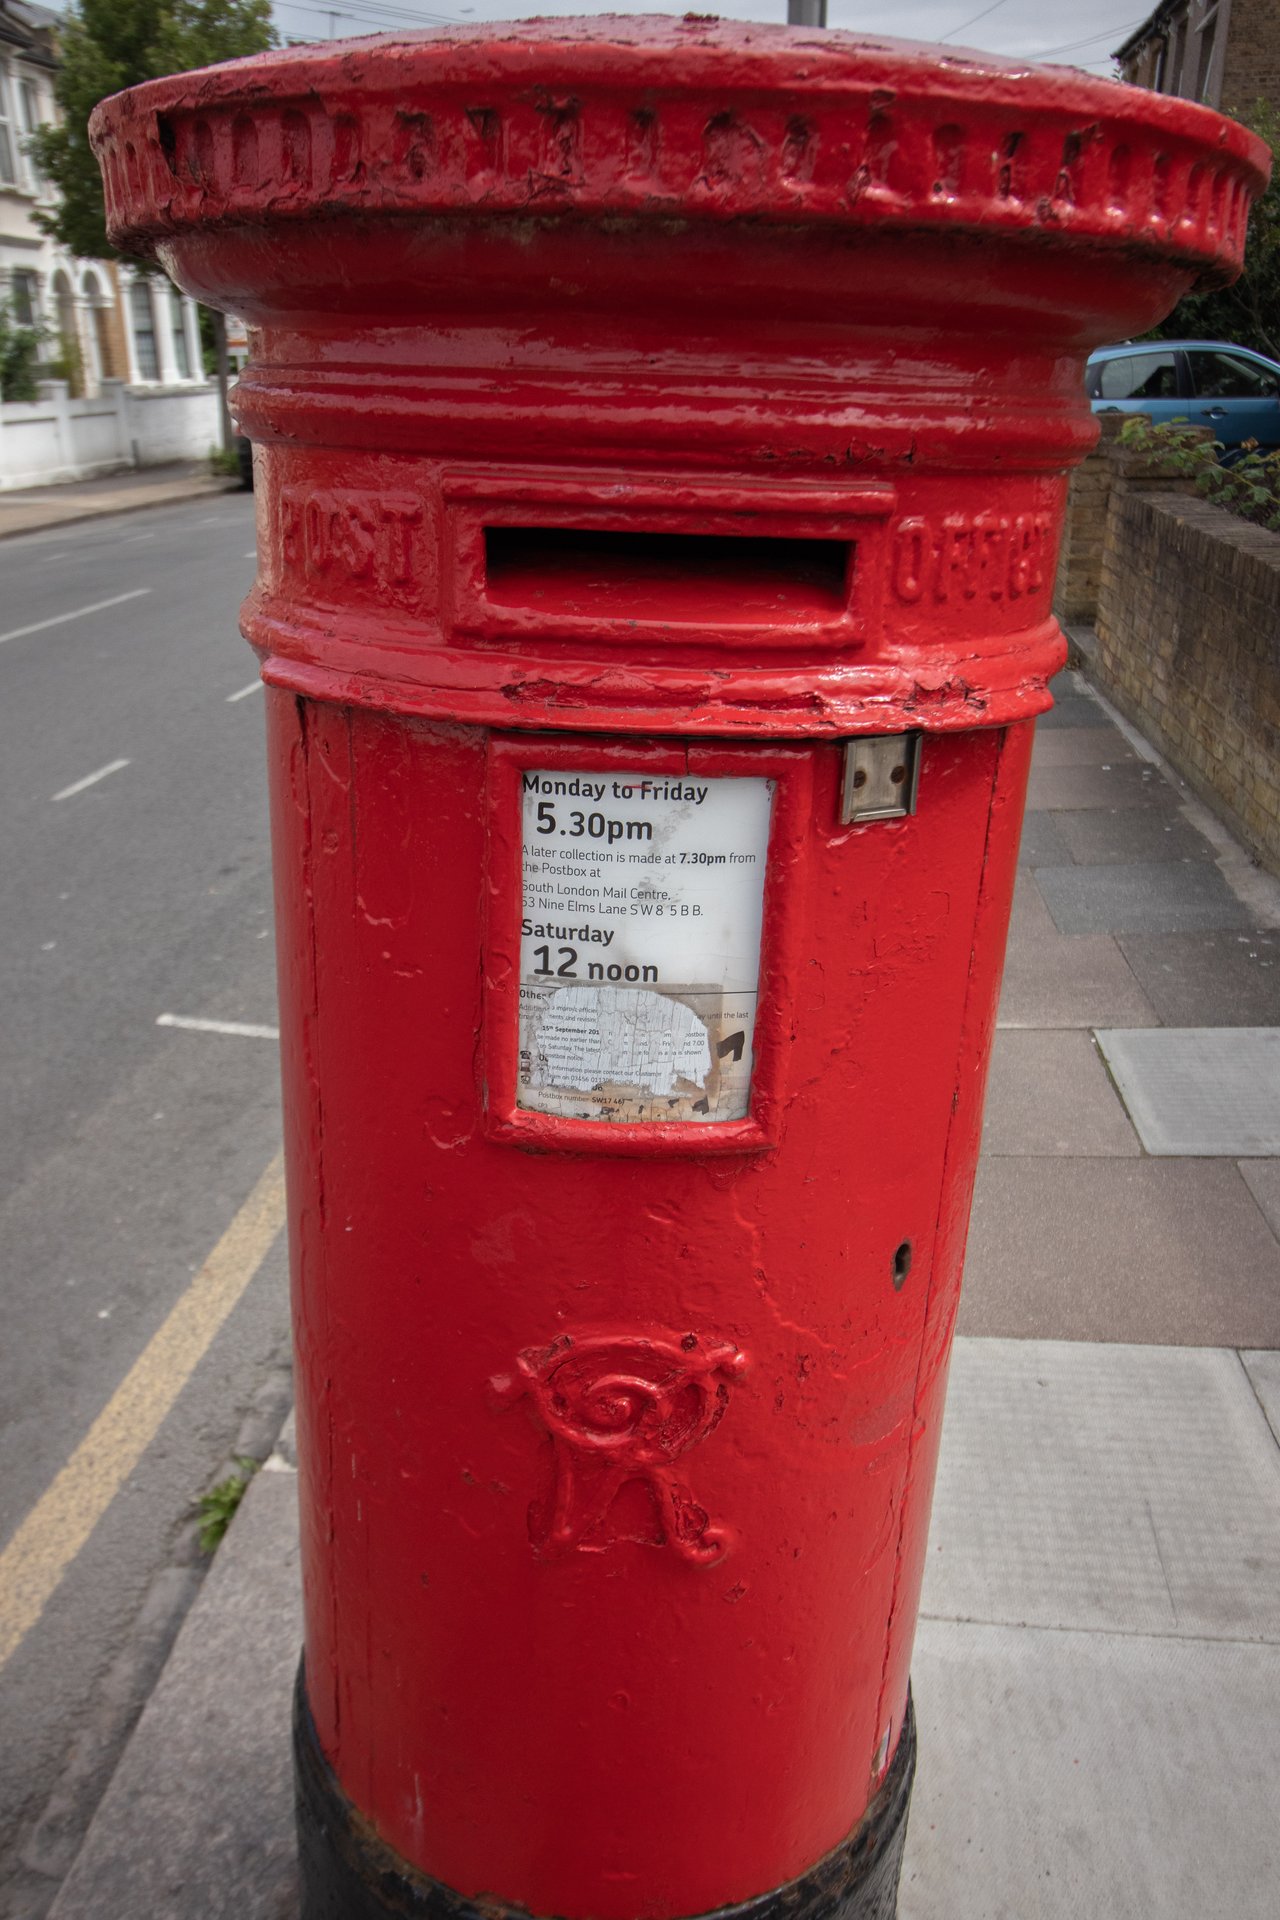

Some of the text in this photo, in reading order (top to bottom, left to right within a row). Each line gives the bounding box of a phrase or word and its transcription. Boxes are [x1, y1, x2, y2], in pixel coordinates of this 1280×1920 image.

[277, 486, 425, 586] POST
[523, 774, 708, 805] Monday to Friday
[536, 802, 653, 844] 5.30pm
[522, 845, 756, 866] A later collection is made at 7.30pm from
[522, 861, 601, 877] the Postbox at
[522, 880, 554, 893] South
[557, 883, 600, 897] London
[603, 886, 627, 899] Mail
[538, 898, 565, 911] Nine
[567, 900, 596, 913] Elms
[598, 902, 627, 915] Lane
[521, 918, 614, 946] Saturday
[533, 945, 659, 983] 12 noon
[724, 1011, 736, 1019] the
[736, 1011, 749, 1019] last
